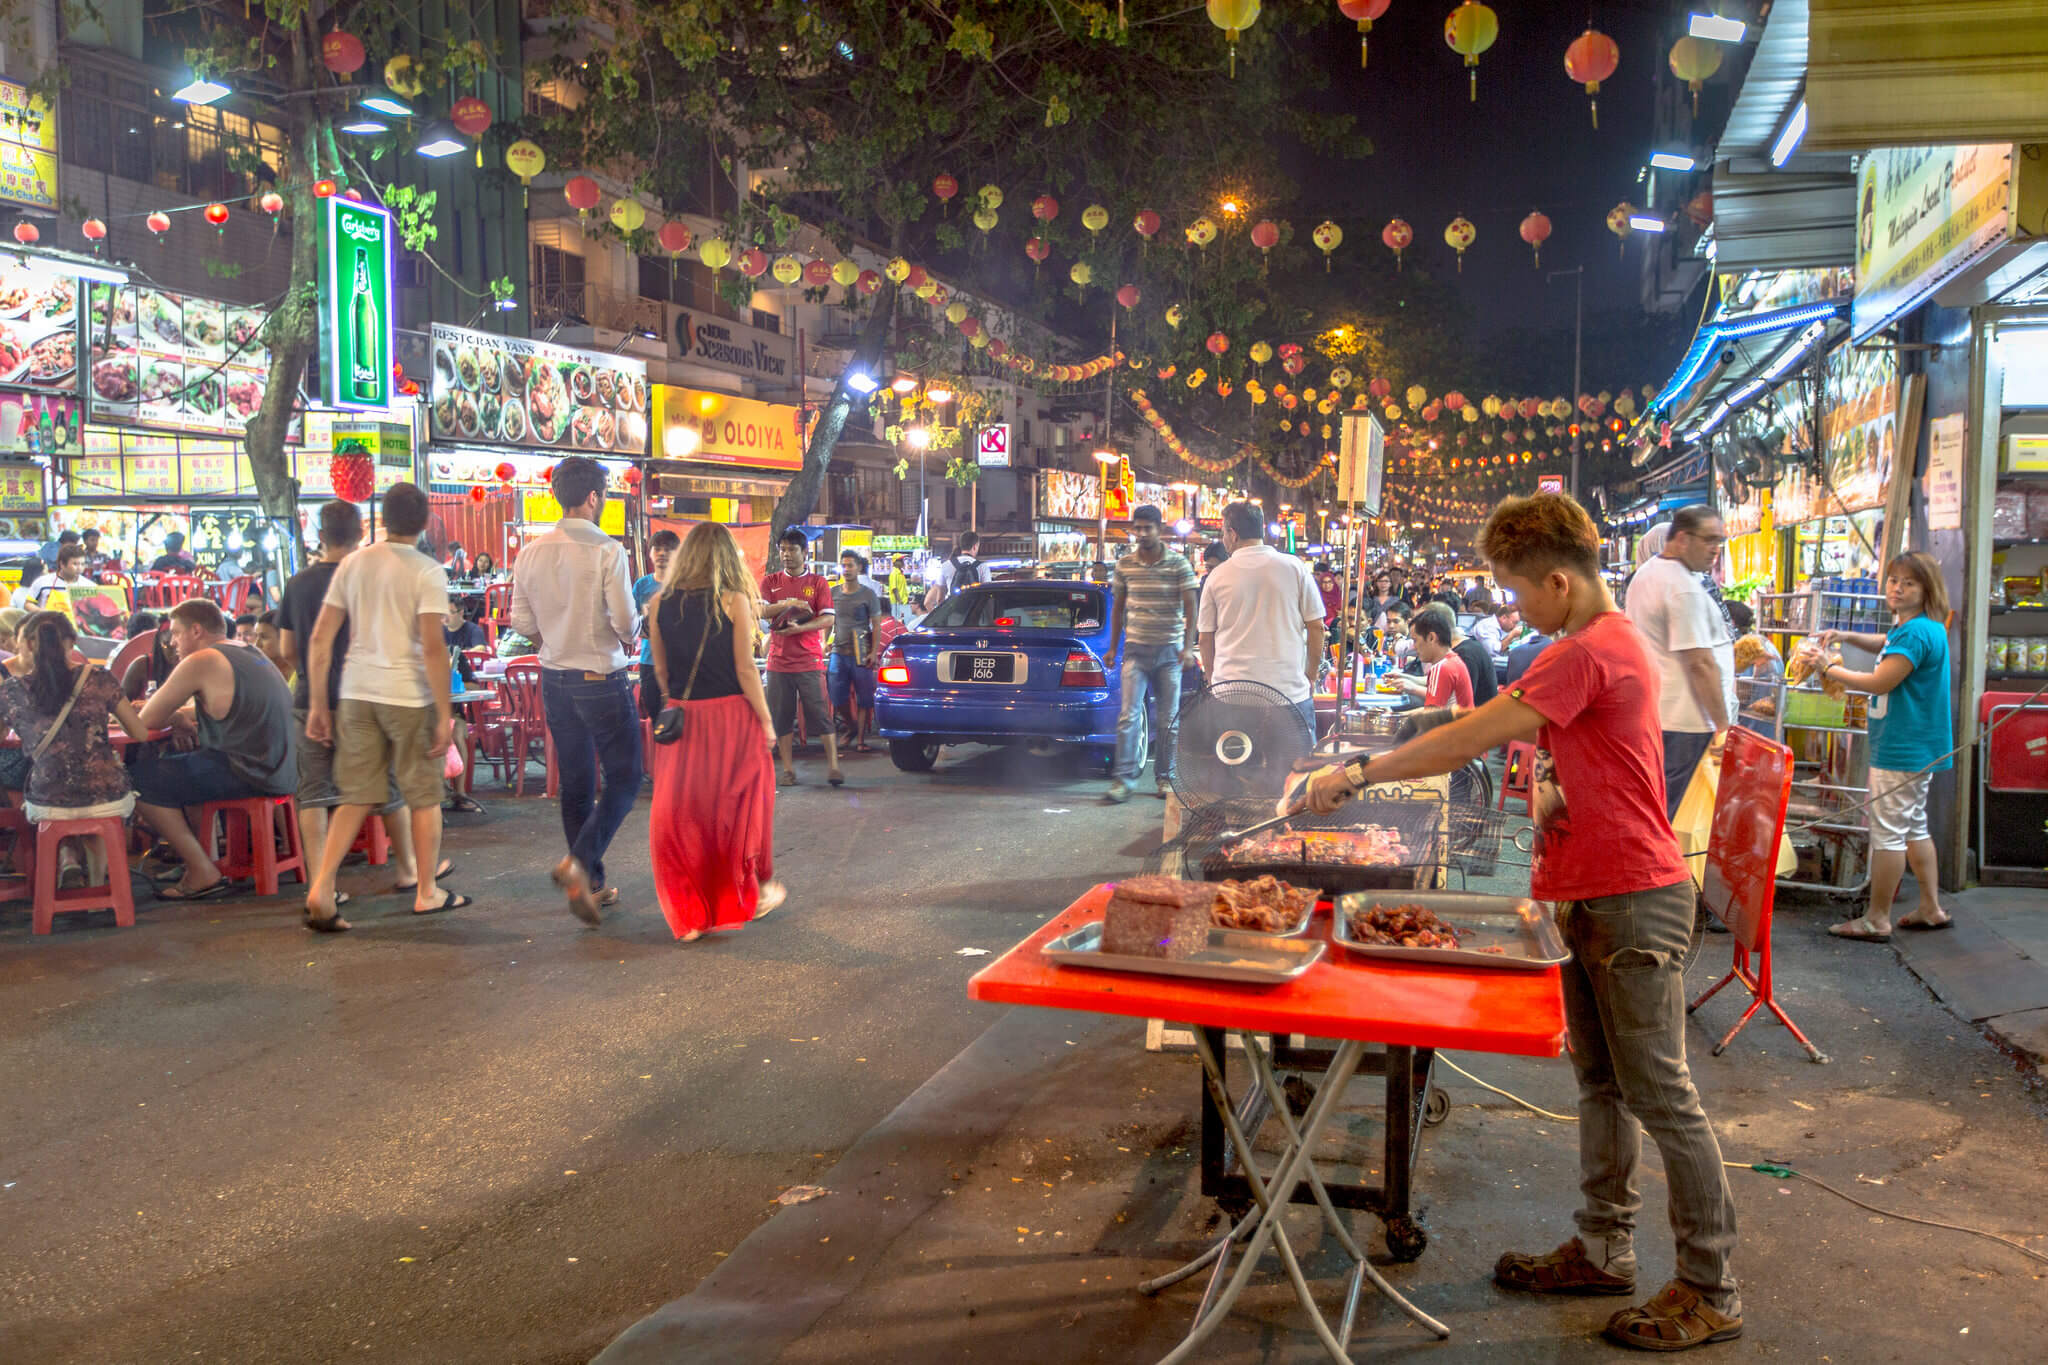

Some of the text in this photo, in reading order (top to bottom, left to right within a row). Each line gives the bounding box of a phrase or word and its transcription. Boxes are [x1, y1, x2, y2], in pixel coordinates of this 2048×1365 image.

[16, 189, 33, 201] Cha
[341, 213, 380, 241] Carlsberg
[433, 328, 500, 349] RESTORAN
[724, 420, 784, 451] OLOIYA
[383, 439, 409, 450] HOTEL
[973, 657, 996, 669] BEB
[973, 668, 994, 679] 1616
